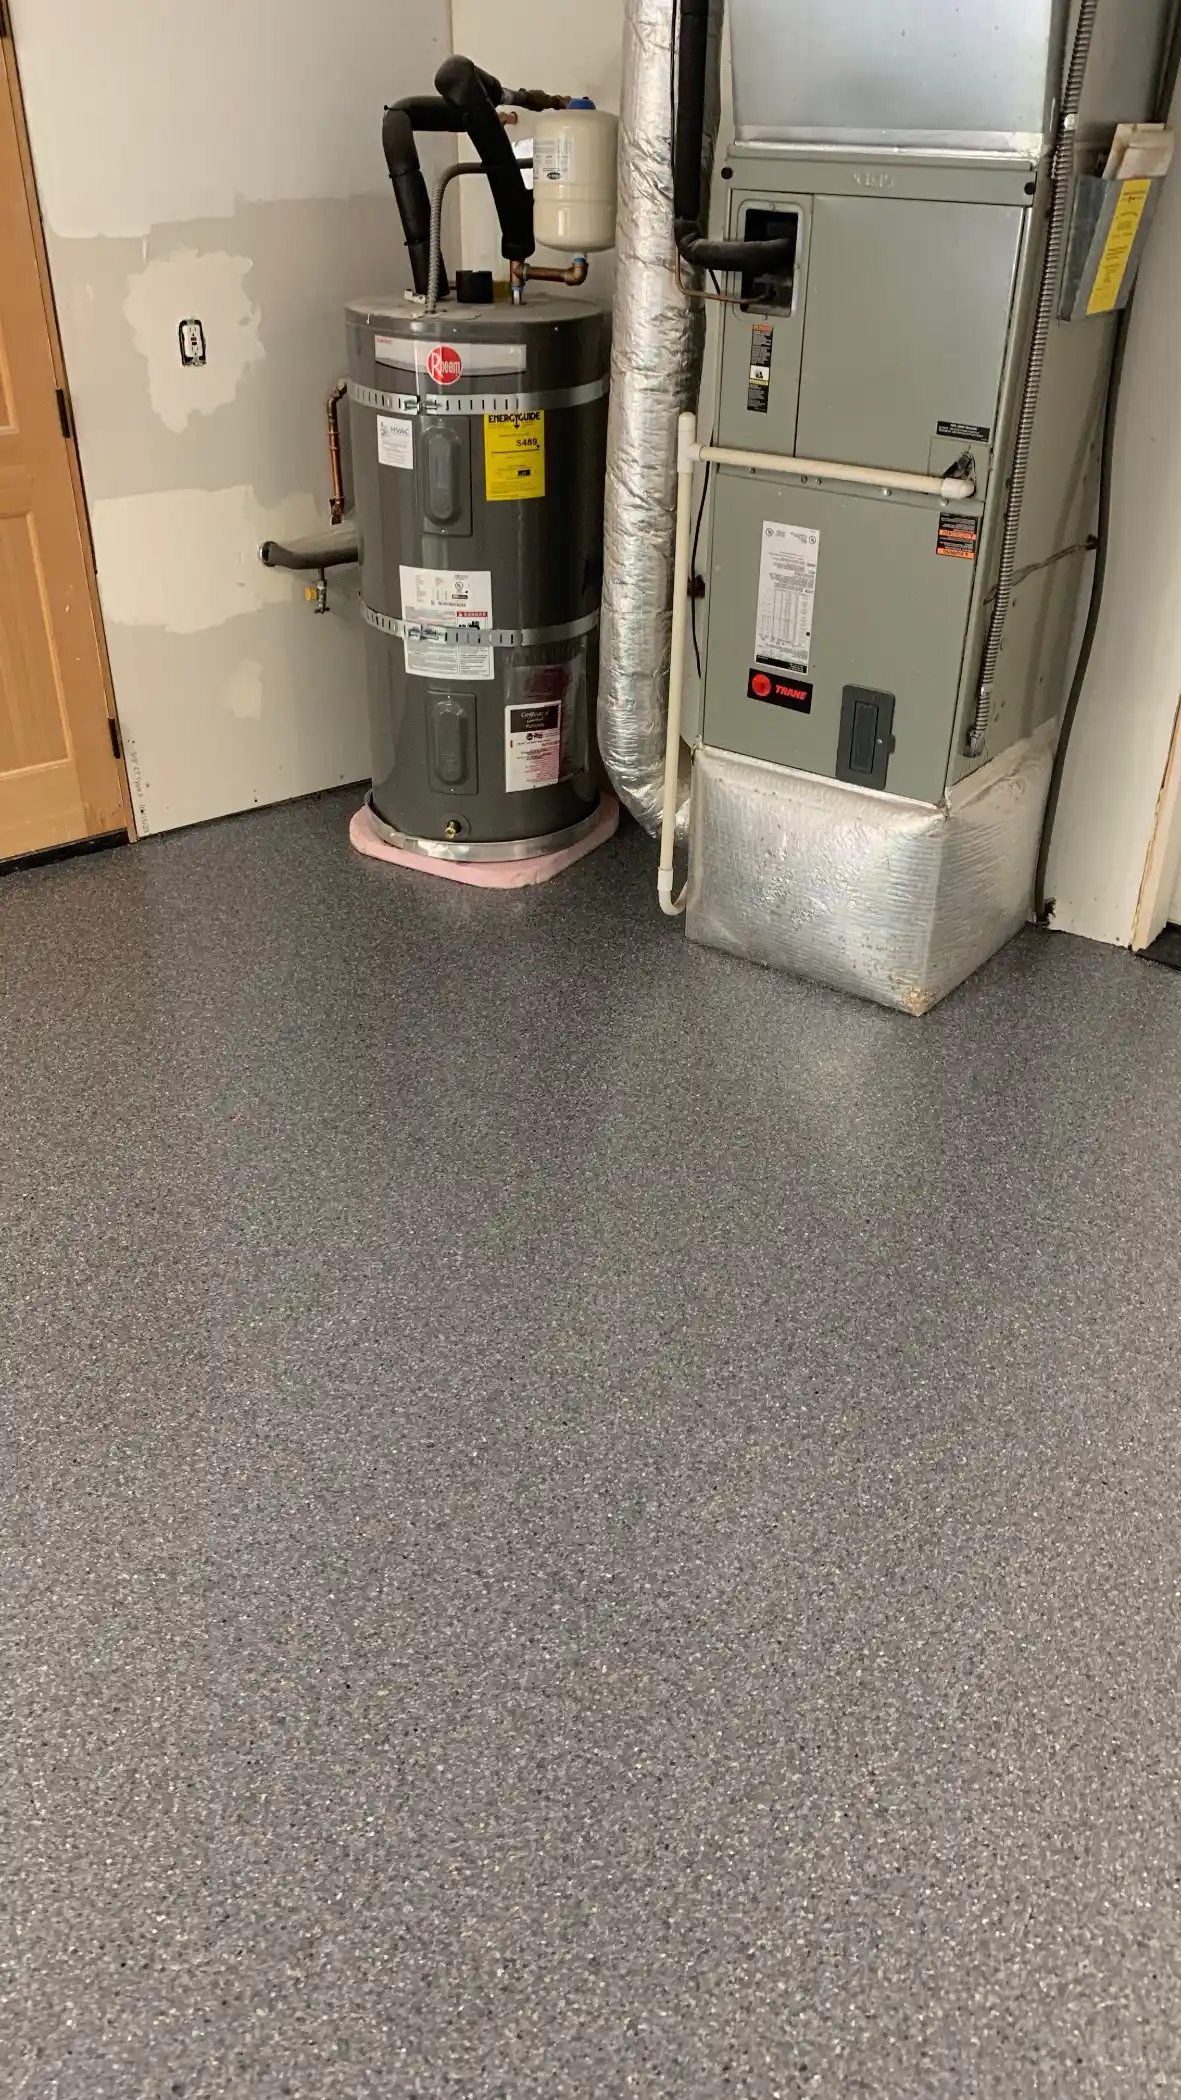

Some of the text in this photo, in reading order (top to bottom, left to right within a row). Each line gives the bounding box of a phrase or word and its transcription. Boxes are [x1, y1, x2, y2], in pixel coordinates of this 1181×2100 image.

[431, 352, 461, 377] Rheem
[488, 411, 541, 423] ENERGYGUIDE
[775, 684, 807, 700] TRANE
